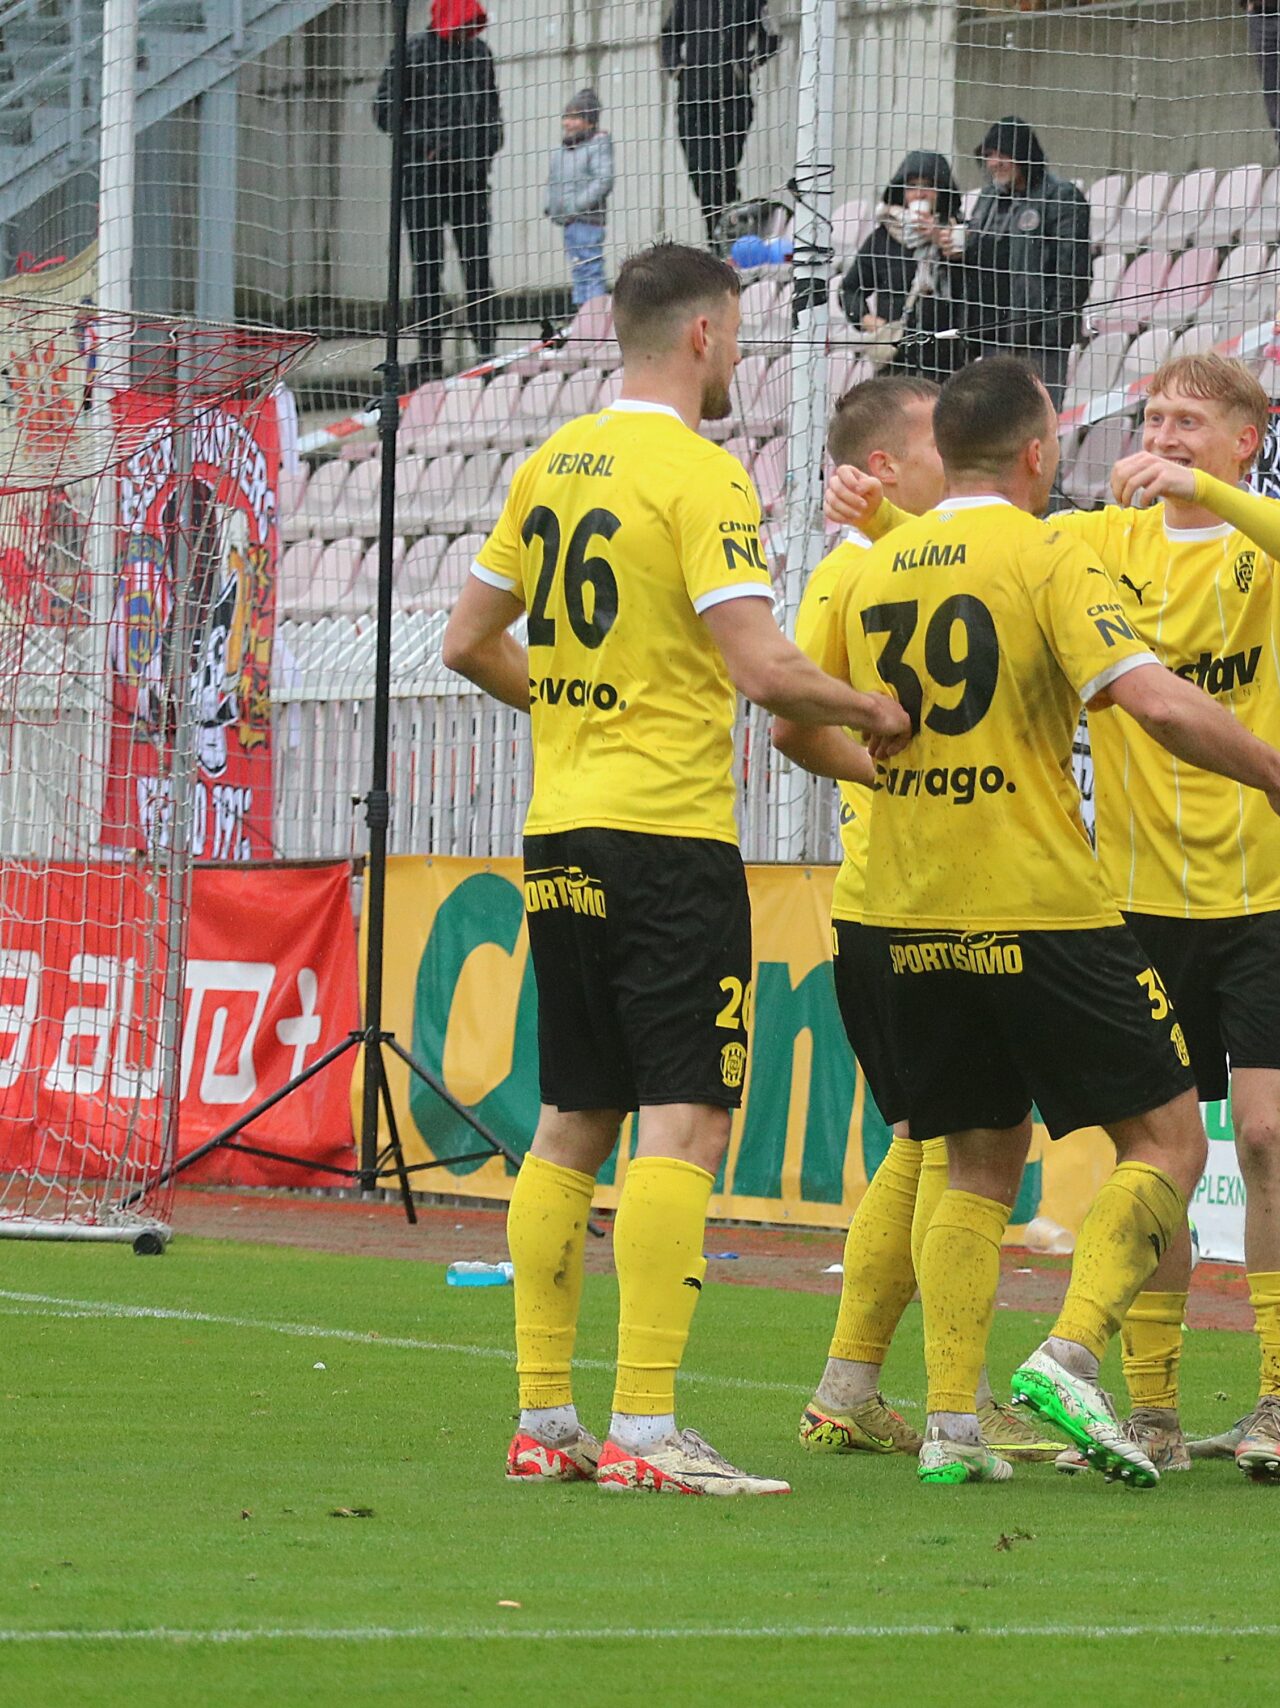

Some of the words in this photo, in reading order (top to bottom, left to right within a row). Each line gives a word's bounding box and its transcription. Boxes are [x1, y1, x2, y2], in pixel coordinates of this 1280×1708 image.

[521, 505, 622, 650] 26
[892, 540, 967, 573] KLÍMA
[860, 594, 999, 738] 39
